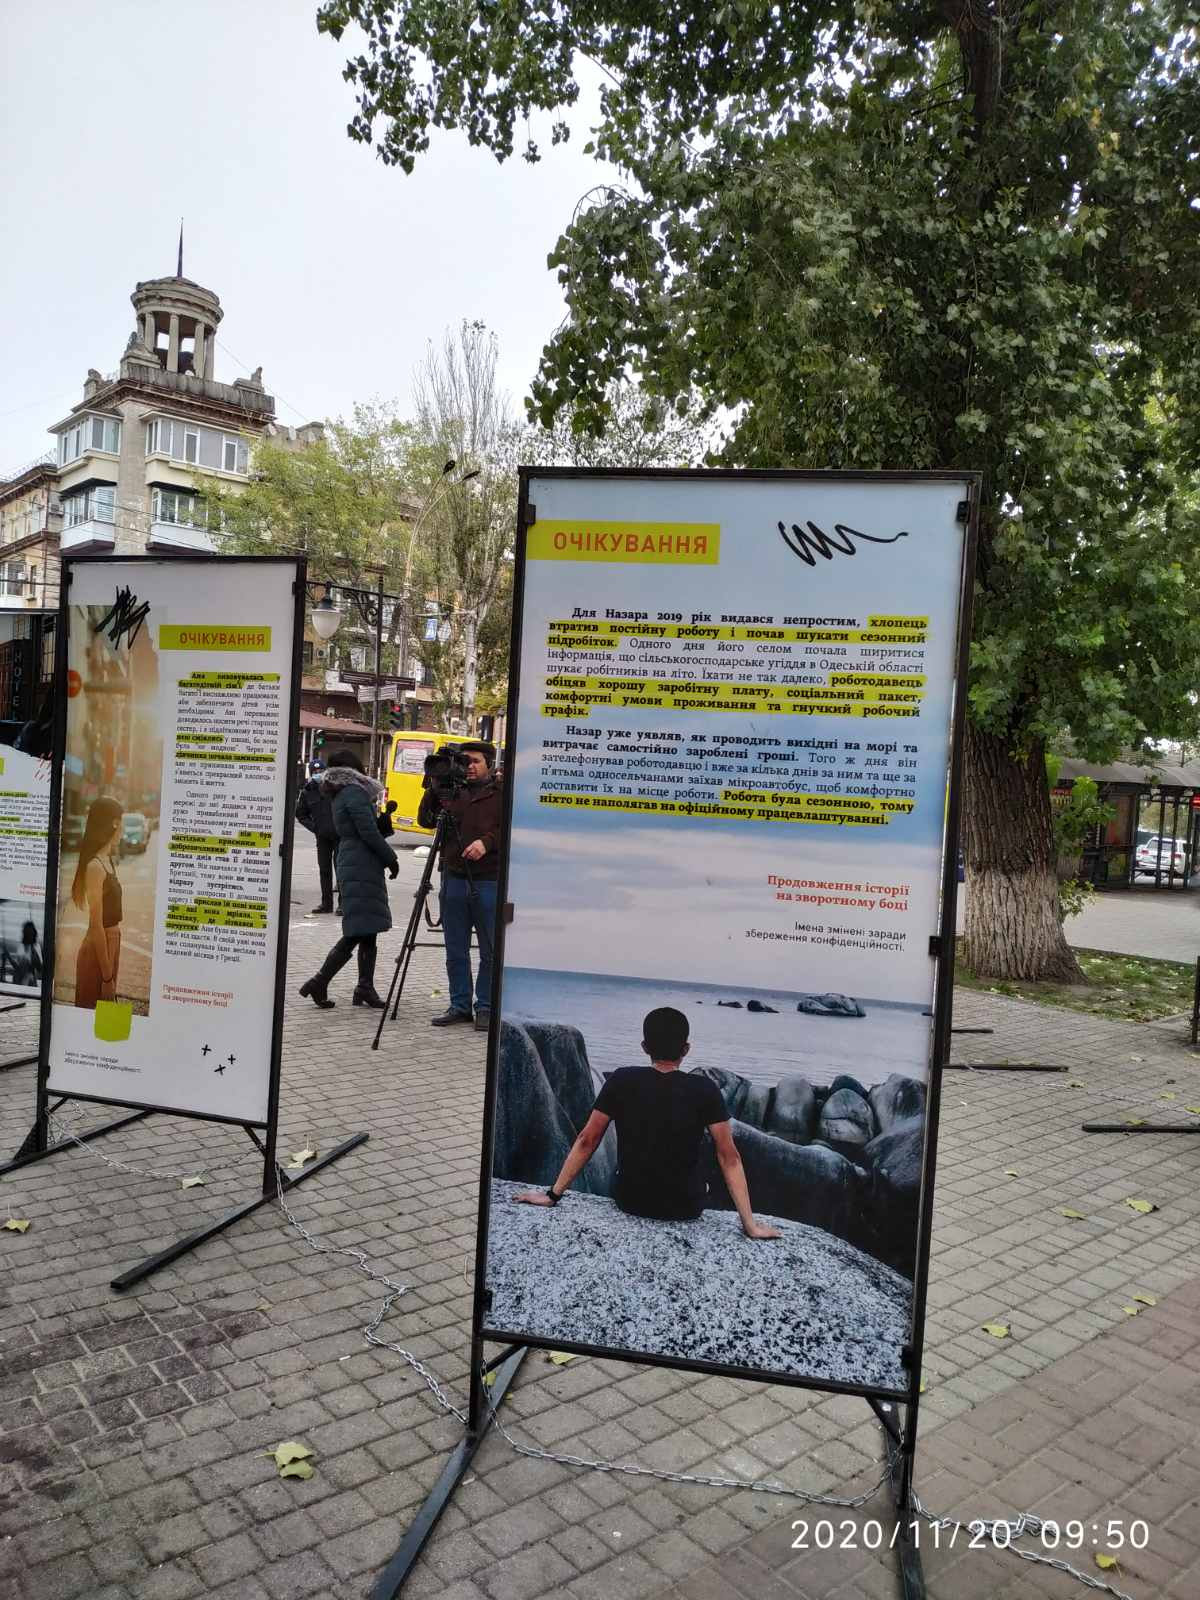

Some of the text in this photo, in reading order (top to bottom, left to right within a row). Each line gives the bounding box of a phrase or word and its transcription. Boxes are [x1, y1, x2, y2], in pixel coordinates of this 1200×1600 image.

[553, 531, 708, 554] ОЧІКУВАННЯ
[571, 607, 927, 630] Для Назара 2019 рік видався непростим, хлопець
[179, 632, 265, 646] ОЧІКУВАННЯ
[549, 623, 598, 635] втратив
[609, 622, 666, 638] постійну
[677, 624, 720, 640] роботу
[746, 629, 784, 639] почав
[796, 631, 848, 643] шукати
[860, 631, 925, 643] сезонний
[548, 633, 924, 659] підробіток. Одного дня його селом почала ширитися
[618, 652, 636, 663] що
[638, 650, 764, 668] сільськогосподарське
[768, 655, 806, 670] угіддя
[819, 658, 875, 671] Одеській
[878, 659, 923, 673] області
[547, 662, 922, 689] шукає робітників на літо. Їхати не так далеко, роботодавець
[545, 674, 921, 704] обіцяв хорошу заробітну плату, соціальний пакет,
[544, 703, 588, 718] графік.
[545, 689, 920, 717] комфортні умови проживання та гнучкий робочий
[566, 724, 918, 754] Назар уже уявляв, як проводить вихідні на морі та
[542, 739, 598, 752] витрачає
[606, 741, 678, 755] самостійно
[685, 745, 748, 759] зароблені
[757, 749, 798, 763] гроші.
[808, 751, 836, 763] Того
[864, 757, 888, 767] дня
[897, 755, 917, 768] він
[542, 752, 624, 768] зателефонував
[626, 755, 702, 772] роботодавцю
[711, 763, 733, 772] вже
[736, 764, 748, 773] за
[751, 762, 789, 775] кілька
[791, 764, 818, 778] днів
[821, 769, 833, 778] за
[836, 770, 863, 779] ним
[866, 771, 879, 780] та
[882, 772, 900, 783] ще
[903, 773, 916, 782] за
[588, 770, 683, 783] односельчанами
[688, 773, 723, 786] заїхав
[727, 775, 810, 793] мікроавтобус,
[815, 781, 841, 794] щоб
[845, 783, 915, 799] комфортно
[539, 780, 914, 815] доставити їх на місце роботи. Робота була сезонною, тому
[539, 792, 888, 825] ніхто не наполягав на офіційному працевлаштуванні.
[767, 875, 910, 898] Продовження історії
[776, 892, 909, 911] на зворотному боці
[744, 928, 905, 952] збереження конфіденційності.
[794, 921, 907, 941] Імена змінені заради
